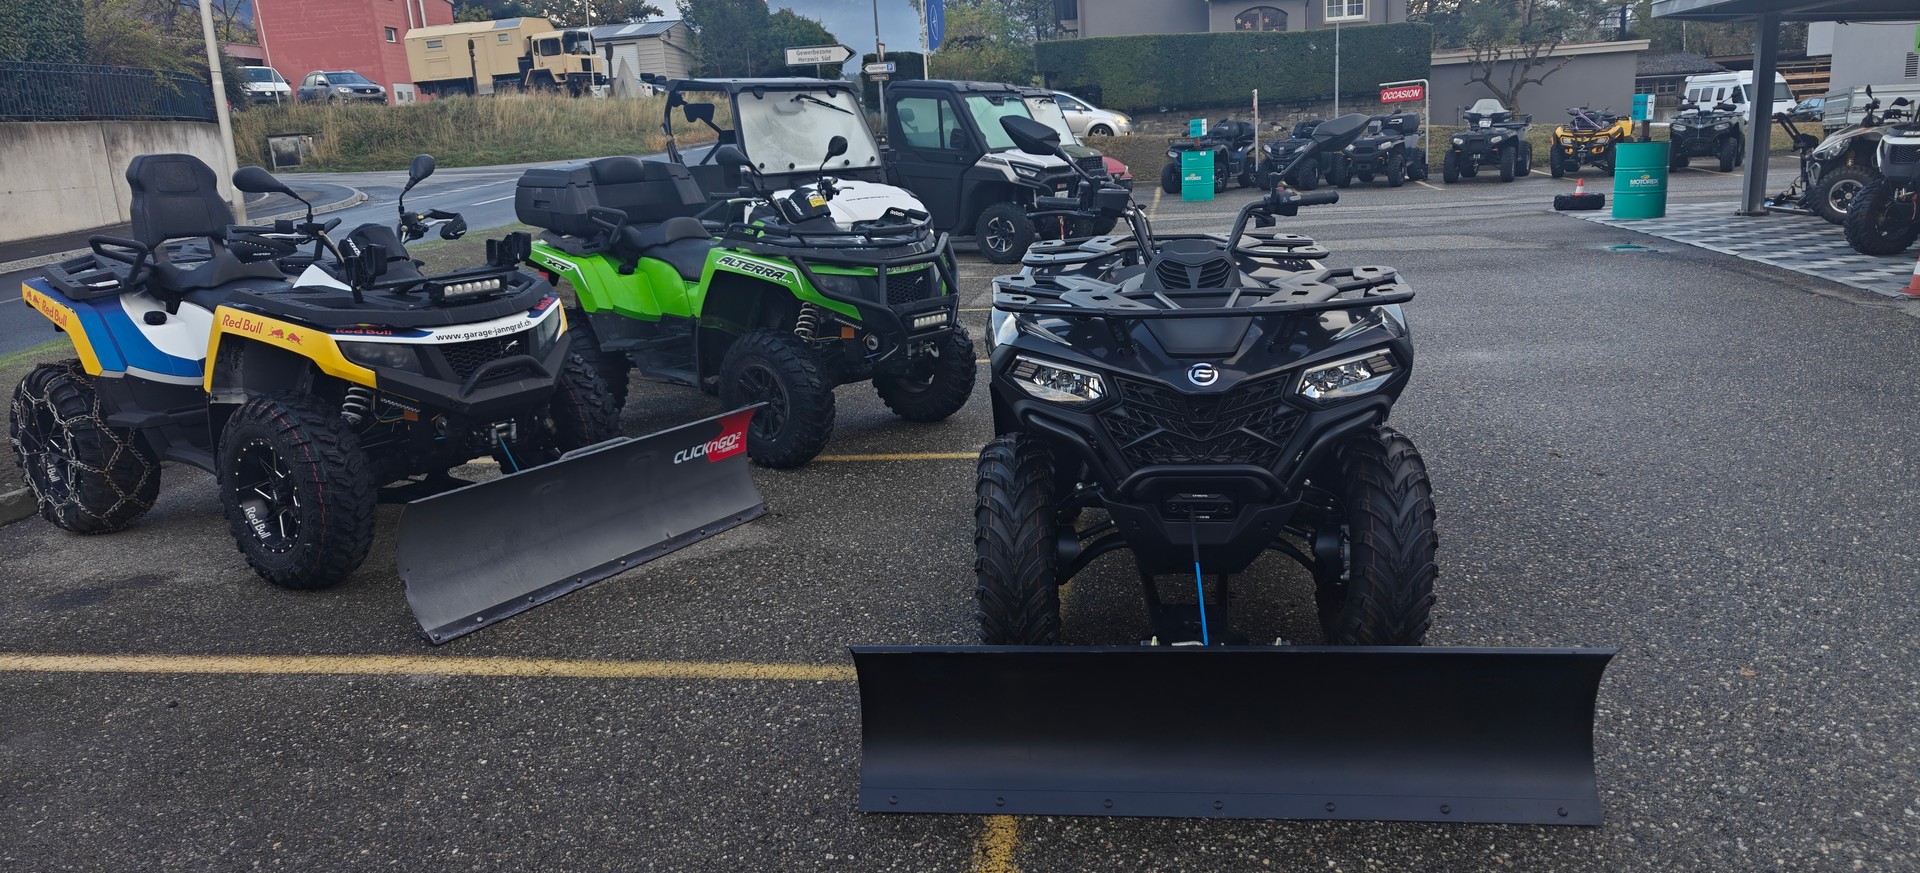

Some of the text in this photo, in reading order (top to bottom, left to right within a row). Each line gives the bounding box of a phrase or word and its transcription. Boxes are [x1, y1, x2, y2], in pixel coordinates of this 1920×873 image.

[1382, 89, 1420, 100] OCCASION
[718, 256, 786, 281] ALTERRA
[41, 299, 68, 327] Red Bull
[222, 314, 264, 334] Red Bull
[435, 319, 532, 341] www.garage-janngraf.ch
[245, 506, 272, 539] Red Bull
